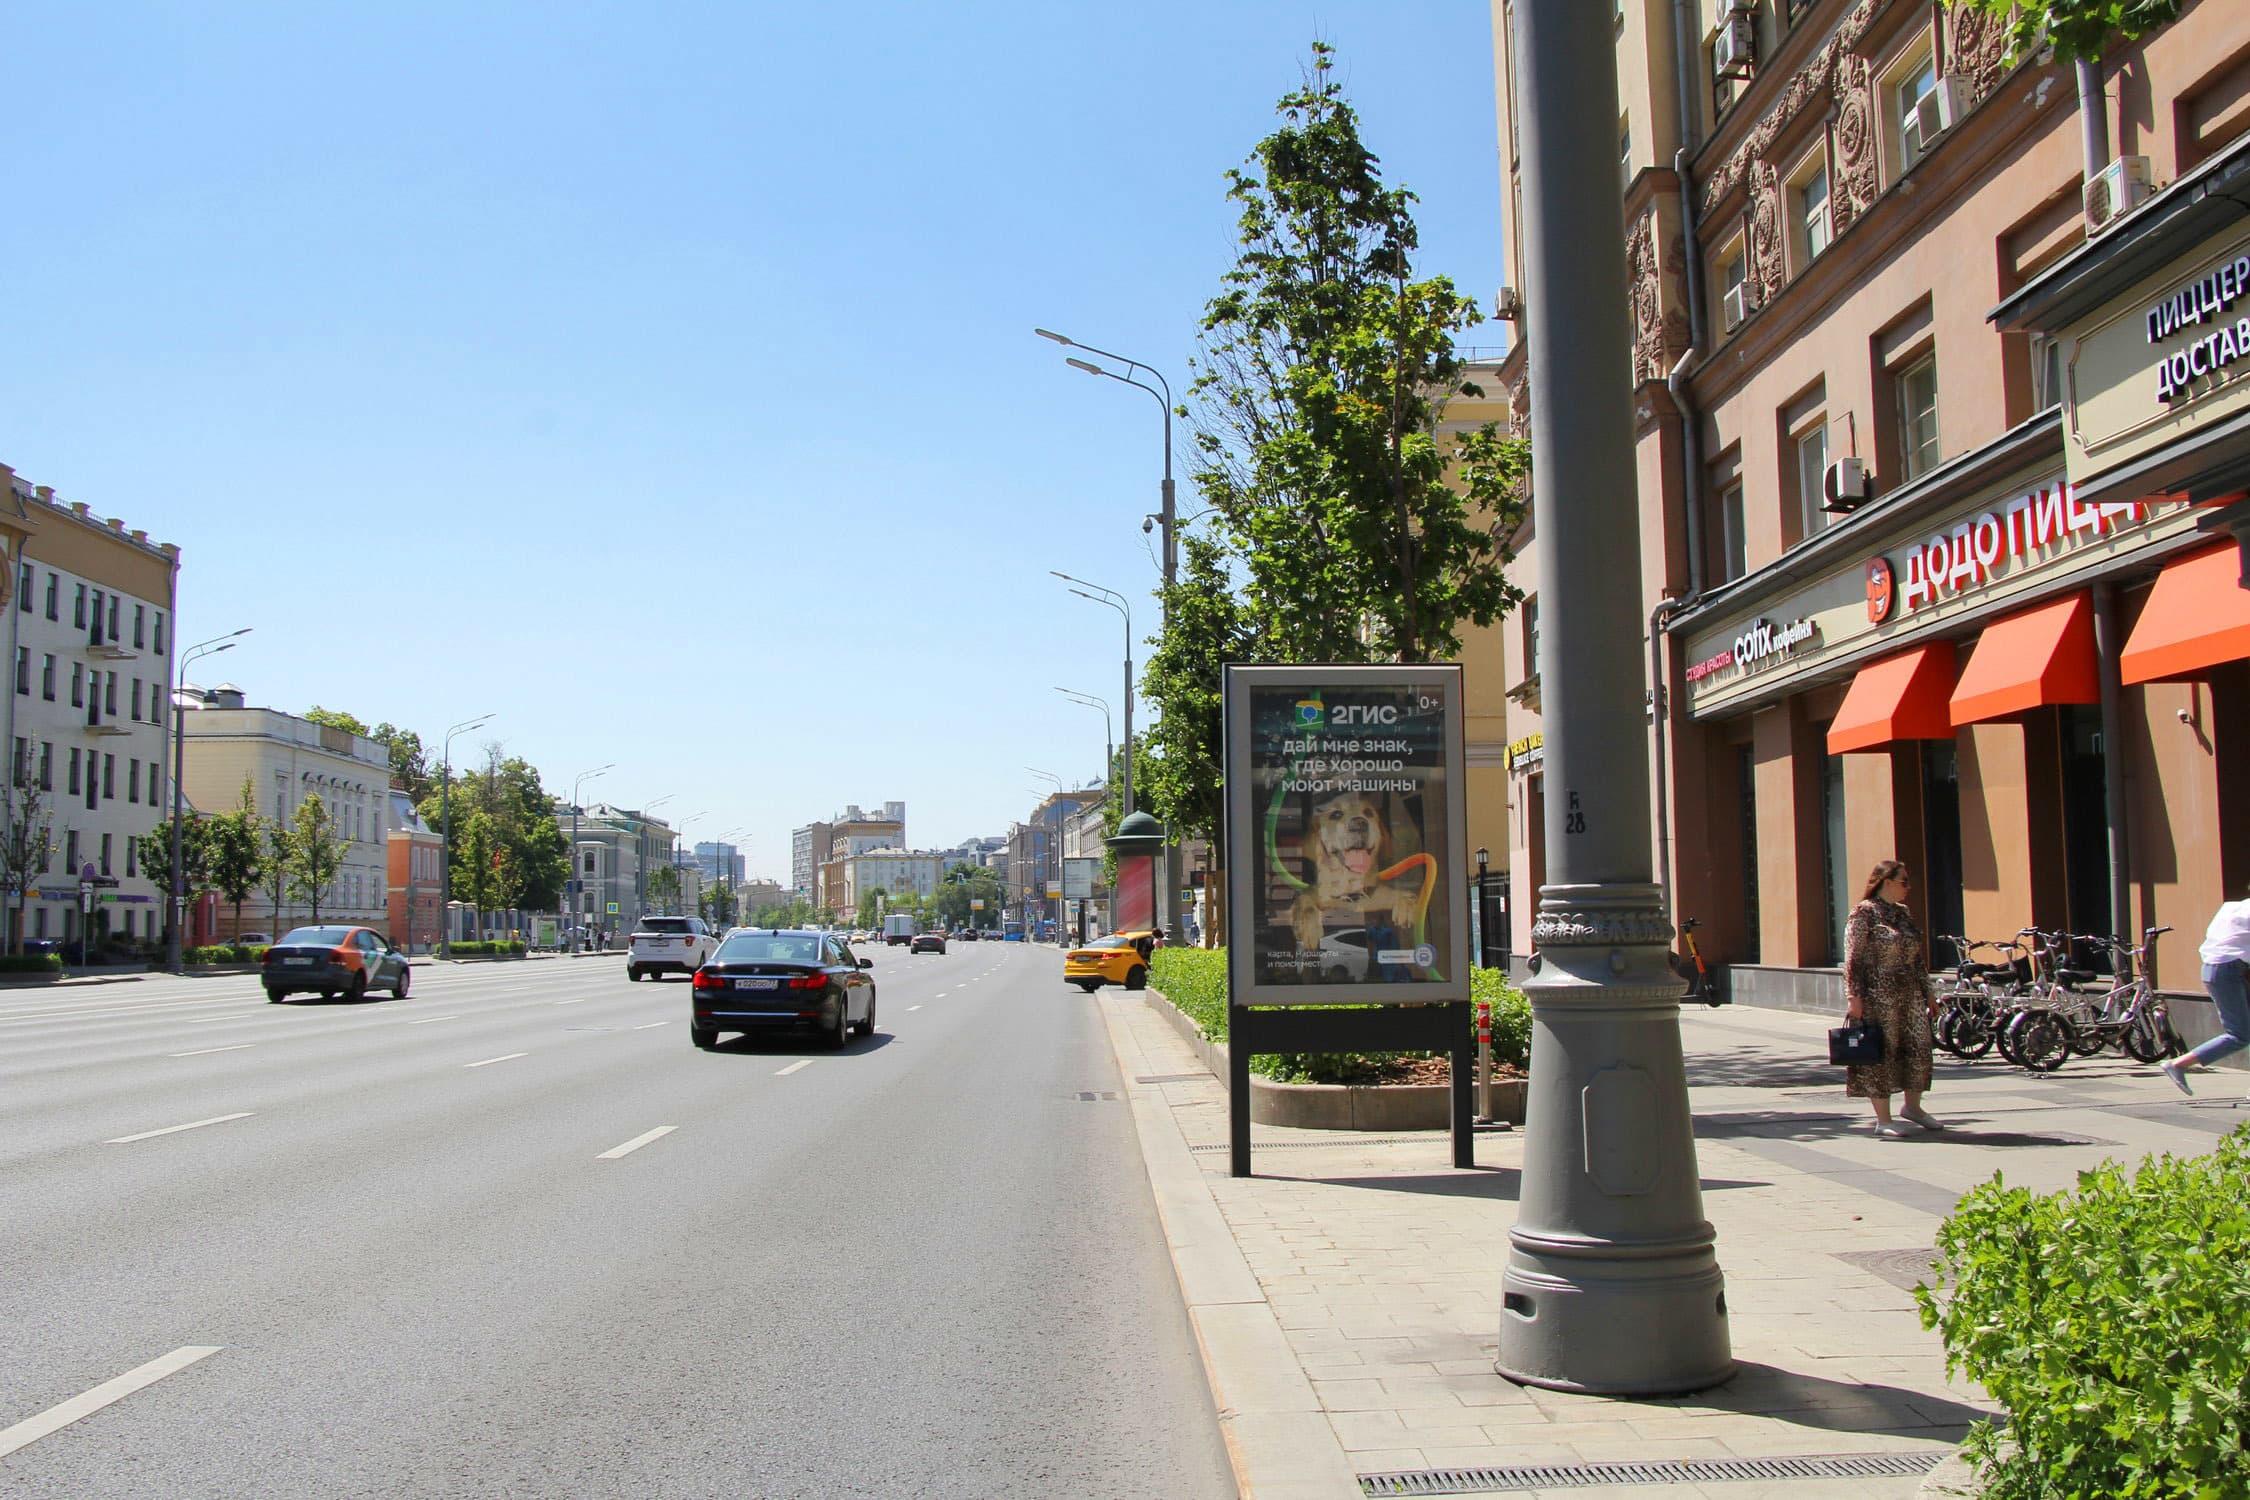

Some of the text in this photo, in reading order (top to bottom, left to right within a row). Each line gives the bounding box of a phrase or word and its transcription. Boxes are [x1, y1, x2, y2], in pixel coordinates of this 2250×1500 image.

[1906, 512, 2002, 605] ДОДО
[1773, 619, 1812, 653] кофейня
[1419, 696, 1439, 710] 0+
[1331, 705, 1398, 725] 2ГИС
[1282, 734, 1413, 755] дай мне знак,
[1295, 759, 1404, 775] где хорошо
[1282, 779, 1417, 792] моют машины
[1566, 811, 1586, 834] 28
